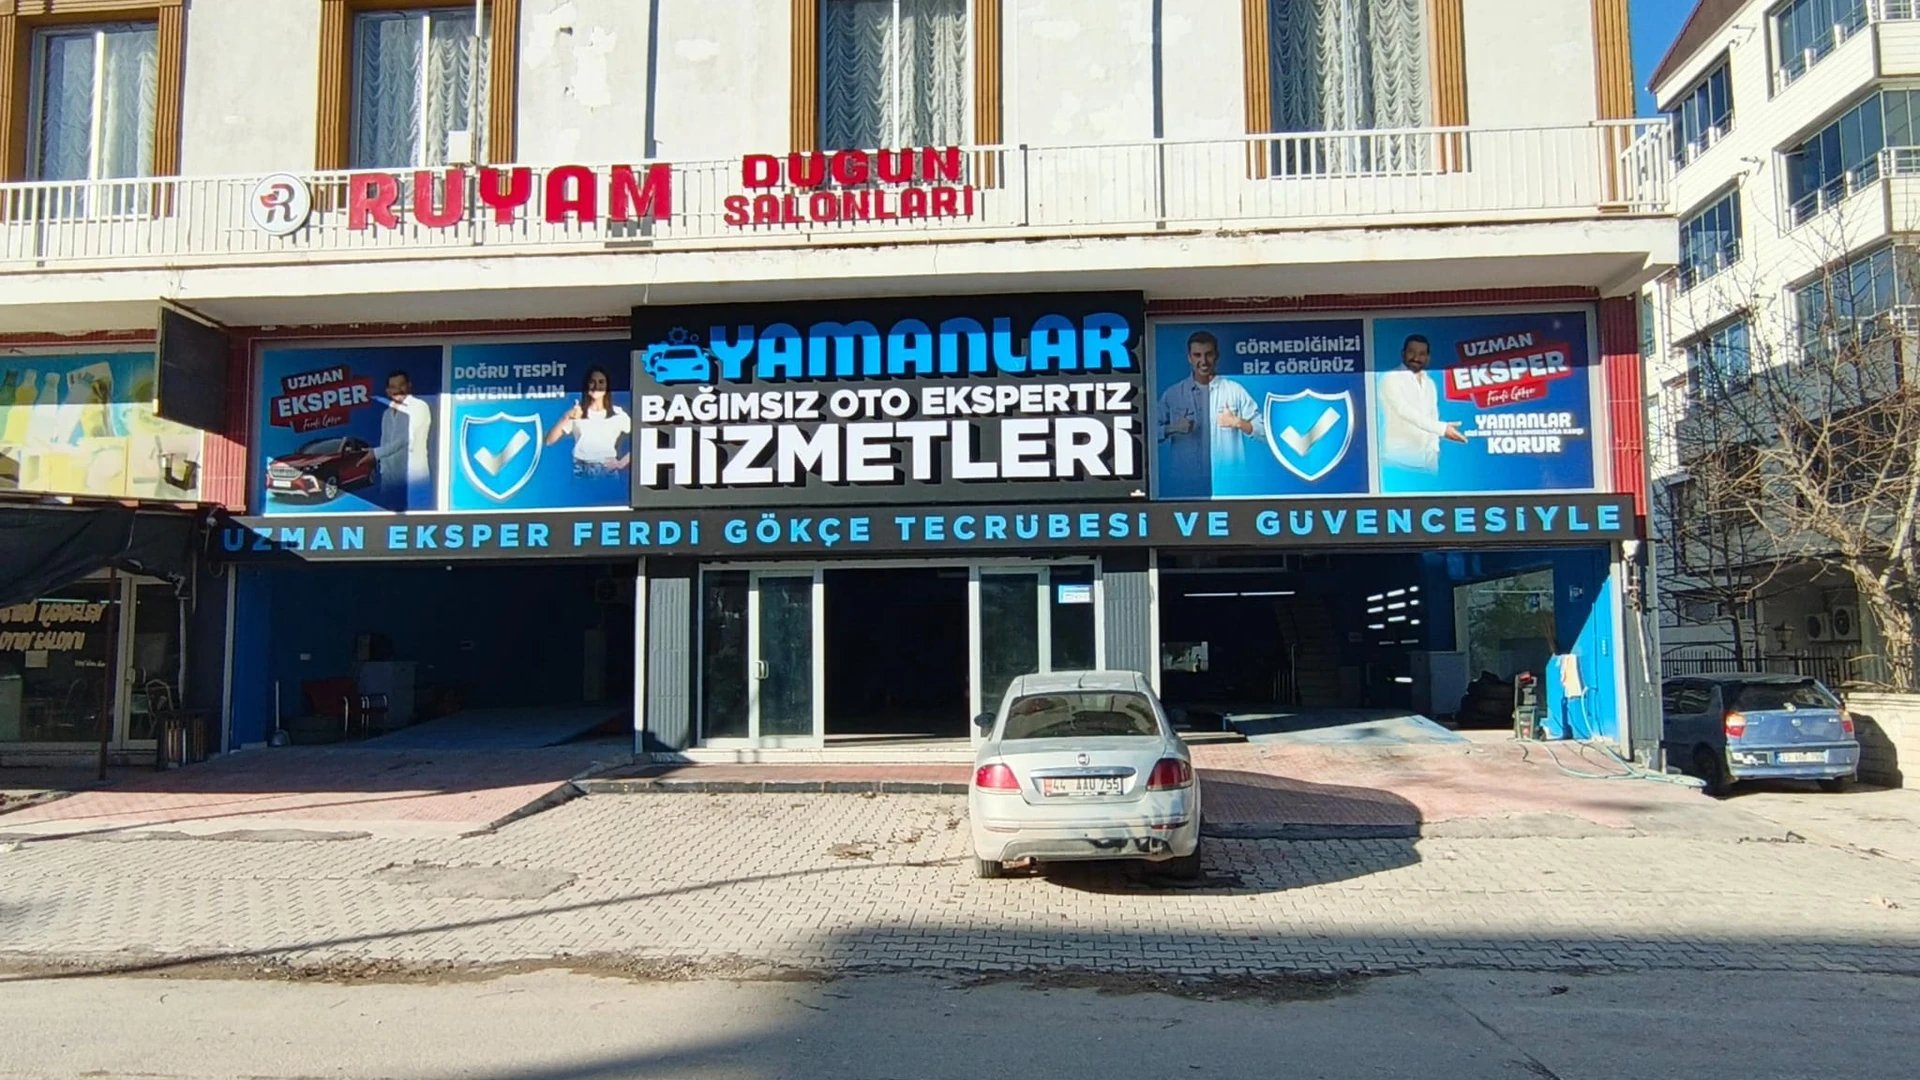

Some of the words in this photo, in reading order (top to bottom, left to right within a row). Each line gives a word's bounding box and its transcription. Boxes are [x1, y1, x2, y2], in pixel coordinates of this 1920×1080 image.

[347, 162, 672, 230] RUYAM
[723, 186, 974, 226] SALONLARI
[708, 312, 1132, 380] YAMANLAR
[1235, 335, 1361, 354] GÖRMEDİĞİNİZİ
[1463, 332, 1534, 358] UZMAN
[287, 368, 344, 390] UZMAN
[454, 363, 509, 379] DOĞRU
[513, 360, 567, 378] TESPİT
[1243, 359, 1270, 375] BİZ
[1274, 356, 1355, 374] GÖRÜRÜZ
[1453, 350, 1569, 391] EKSPER
[278, 384, 369, 418] EKSPER
[455, 383, 522, 400] GÜVENLİ
[525, 384, 565, 399] ALIM
[640, 386, 820, 423] BAĞIMSIZ
[829, 388, 911, 418] OTO
[921, 382, 1132, 416] EKSPERTİZ
[1475, 412, 1572, 430] YAMANLAR
[639, 415, 1134, 486] HİZMETLERİ
[1487, 436, 1561, 454] KORUR
[224, 526, 365, 551] UZMAN
[389, 523, 550, 549] EKSPER
[574, 520, 699, 546] FERDİ
[724, 513, 870, 546] GÖKÇE
[895, 512, 1148, 541] TECRÜBESİ
[1174, 512, 1229, 536] VE
[1255, 505, 1620, 535] GÜVENCESİYLE
